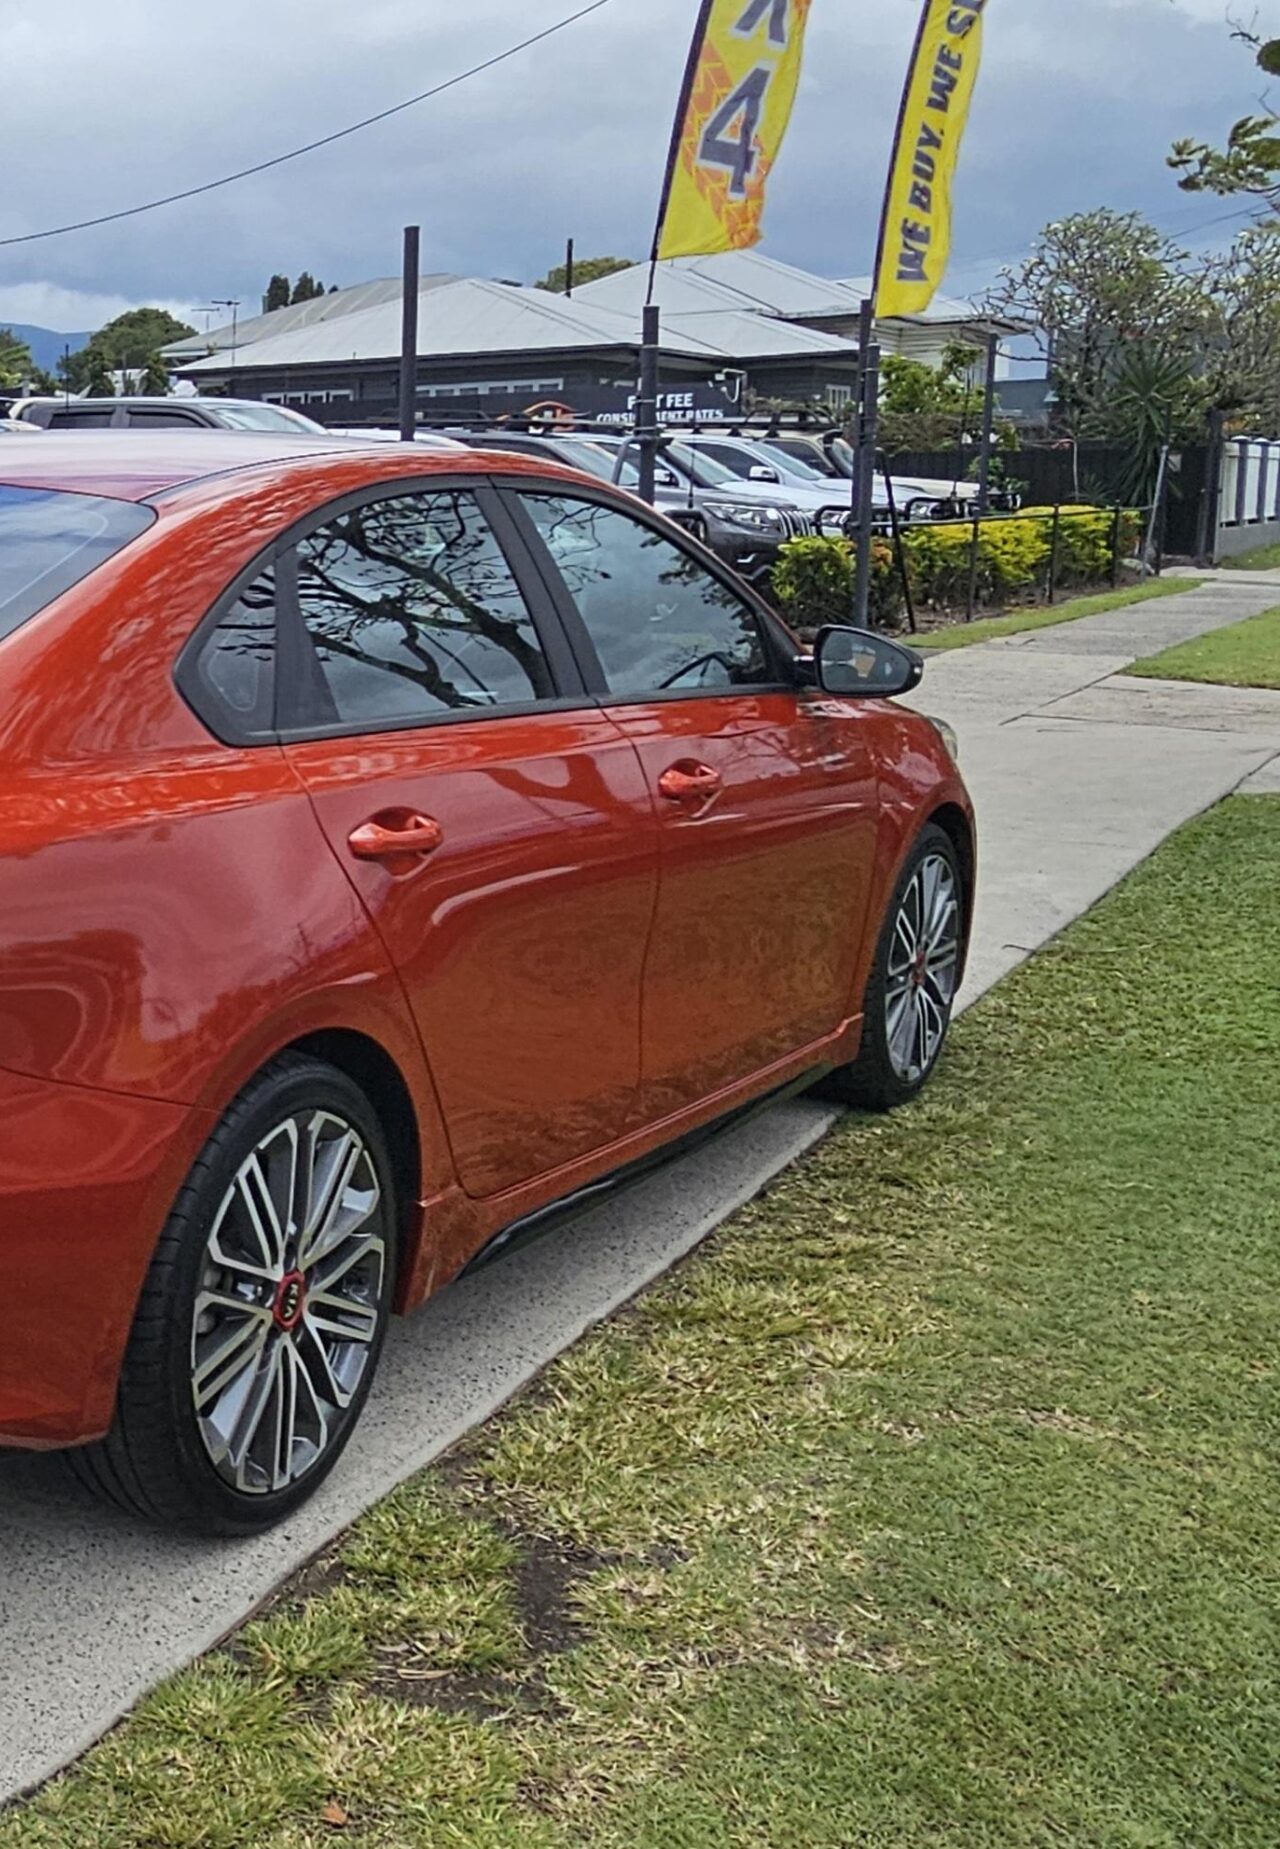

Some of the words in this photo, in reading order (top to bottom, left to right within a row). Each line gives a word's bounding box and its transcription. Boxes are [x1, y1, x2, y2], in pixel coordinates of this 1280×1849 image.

[896, 217, 931, 281] WE
[925, 43, 962, 113] WE
[627, 394, 664, 411] FT
[666, 393, 694, 408] FEE
